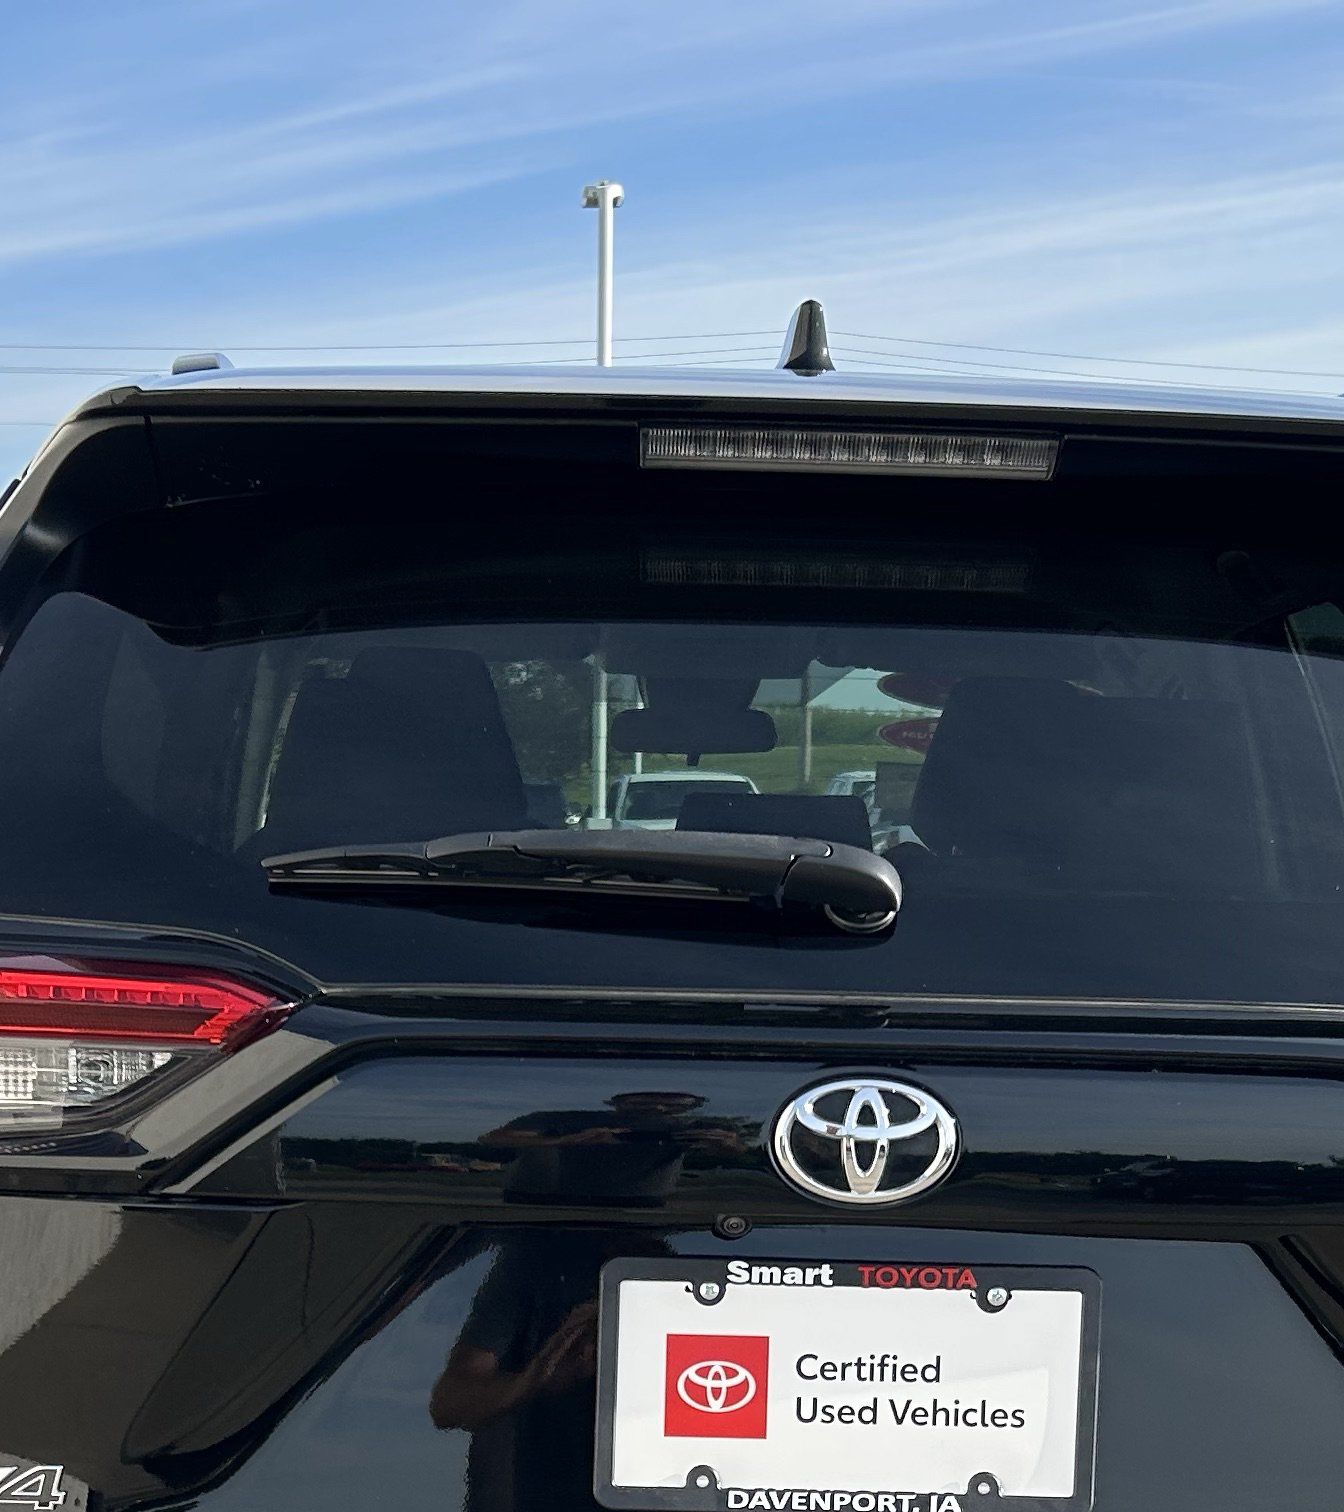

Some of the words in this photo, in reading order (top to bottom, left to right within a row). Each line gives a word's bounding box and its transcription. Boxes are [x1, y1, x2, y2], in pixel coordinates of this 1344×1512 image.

[726, 1259, 834, 1288] Smart
[858, 1265, 979, 1291] TOYOTA
[795, 1353, 942, 1384] Certified
[795, 1396, 878, 1427] Used
[888, 1397, 1026, 1430] Vehicles
